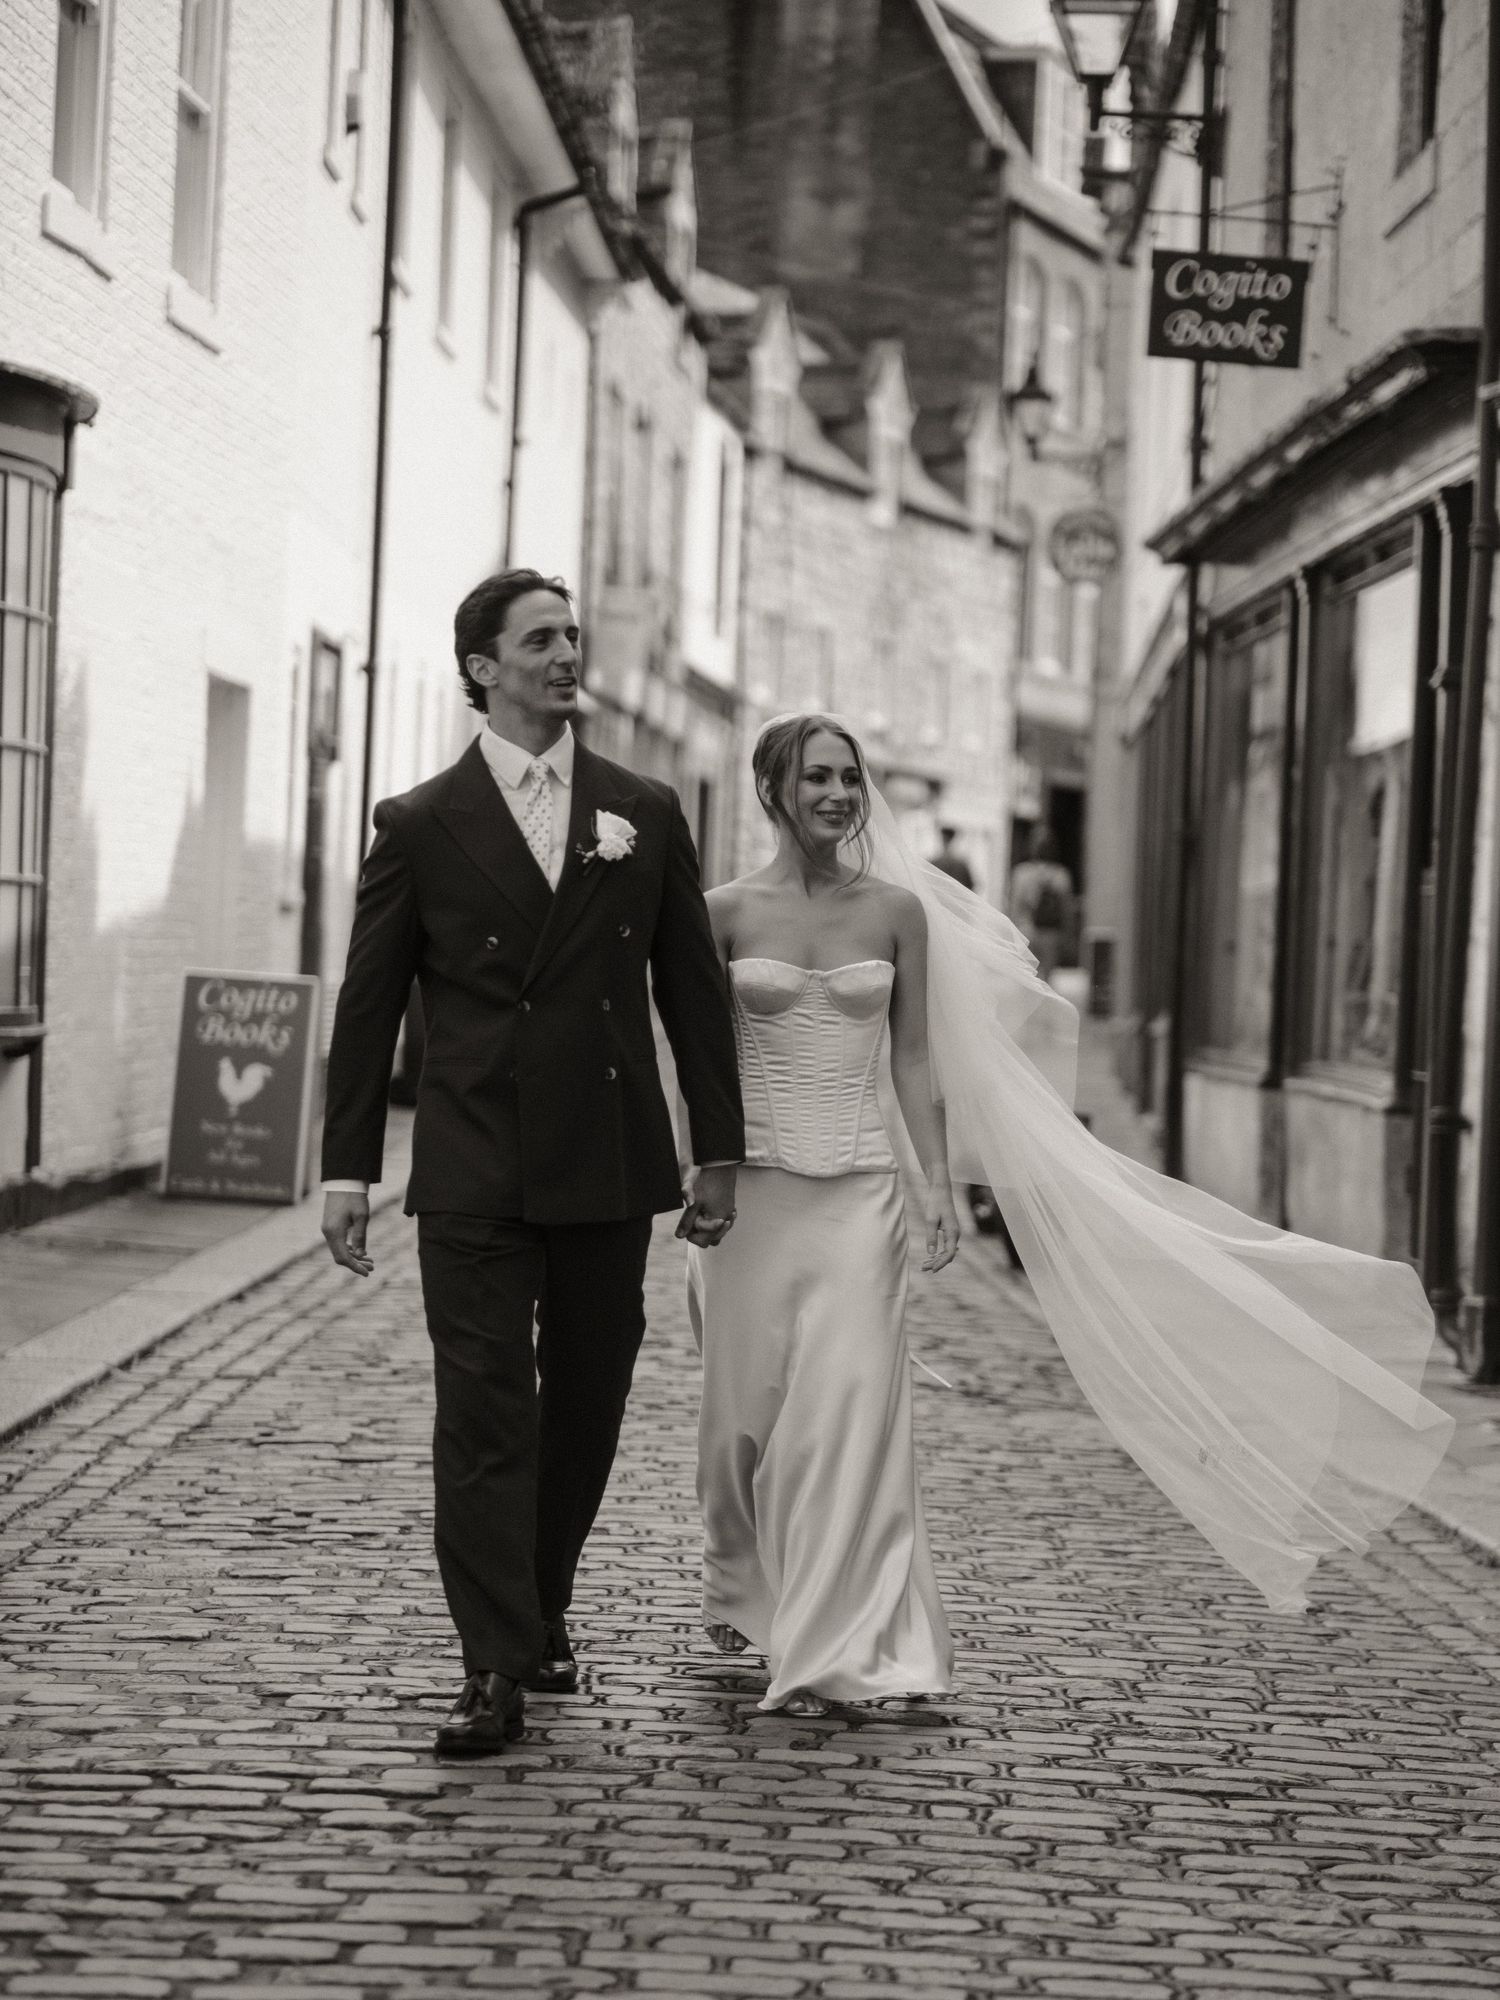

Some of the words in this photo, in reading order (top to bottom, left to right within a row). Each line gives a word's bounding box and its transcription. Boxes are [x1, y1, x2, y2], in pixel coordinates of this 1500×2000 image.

[1164, 258, 1292, 312] Cogito
[1163, 308, 1289, 361] Books
[198, 978, 299, 1021] Cogito
[197, 1012, 295, 1058] Books
